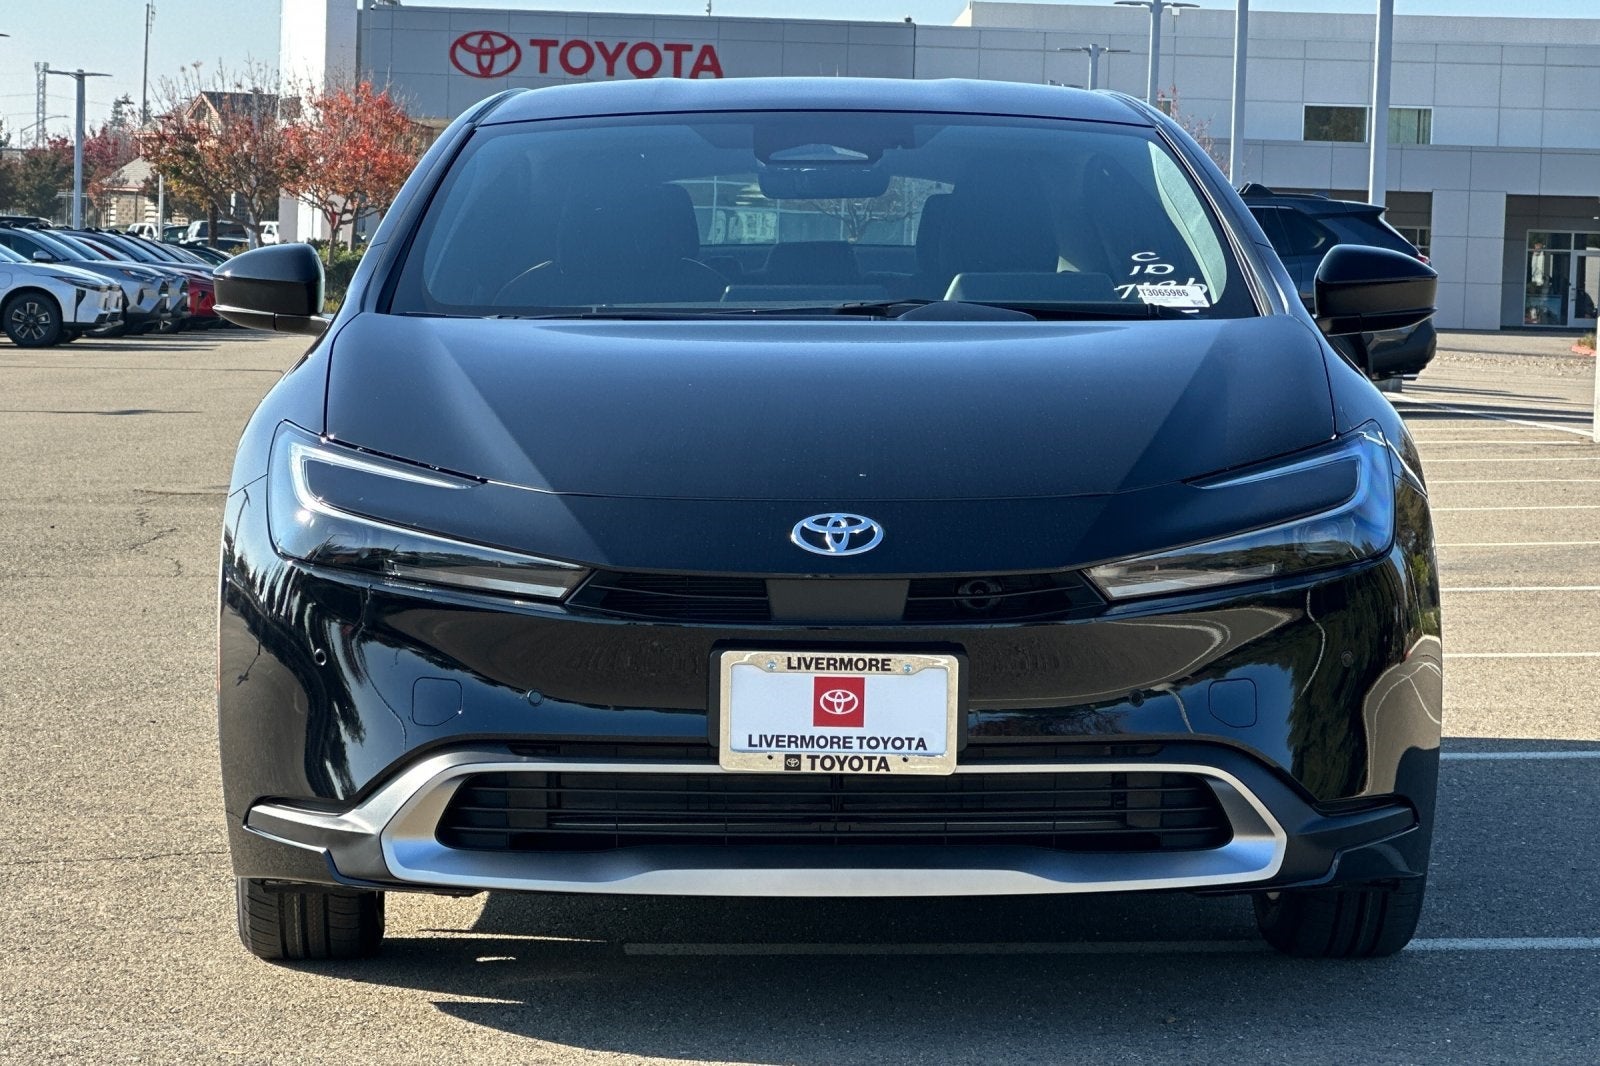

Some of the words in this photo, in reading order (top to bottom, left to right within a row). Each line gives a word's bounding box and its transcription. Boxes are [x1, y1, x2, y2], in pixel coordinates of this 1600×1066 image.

[530, 38, 724, 79] TOYOTA
[1139, 288, 1189, 297] T3065986
[786, 656, 892, 672] LIVERMORE
[747, 734, 853, 750] LIVERMORE
[856, 735, 927, 751] TOYOTA
[806, 754, 891, 772] TOYOTA
